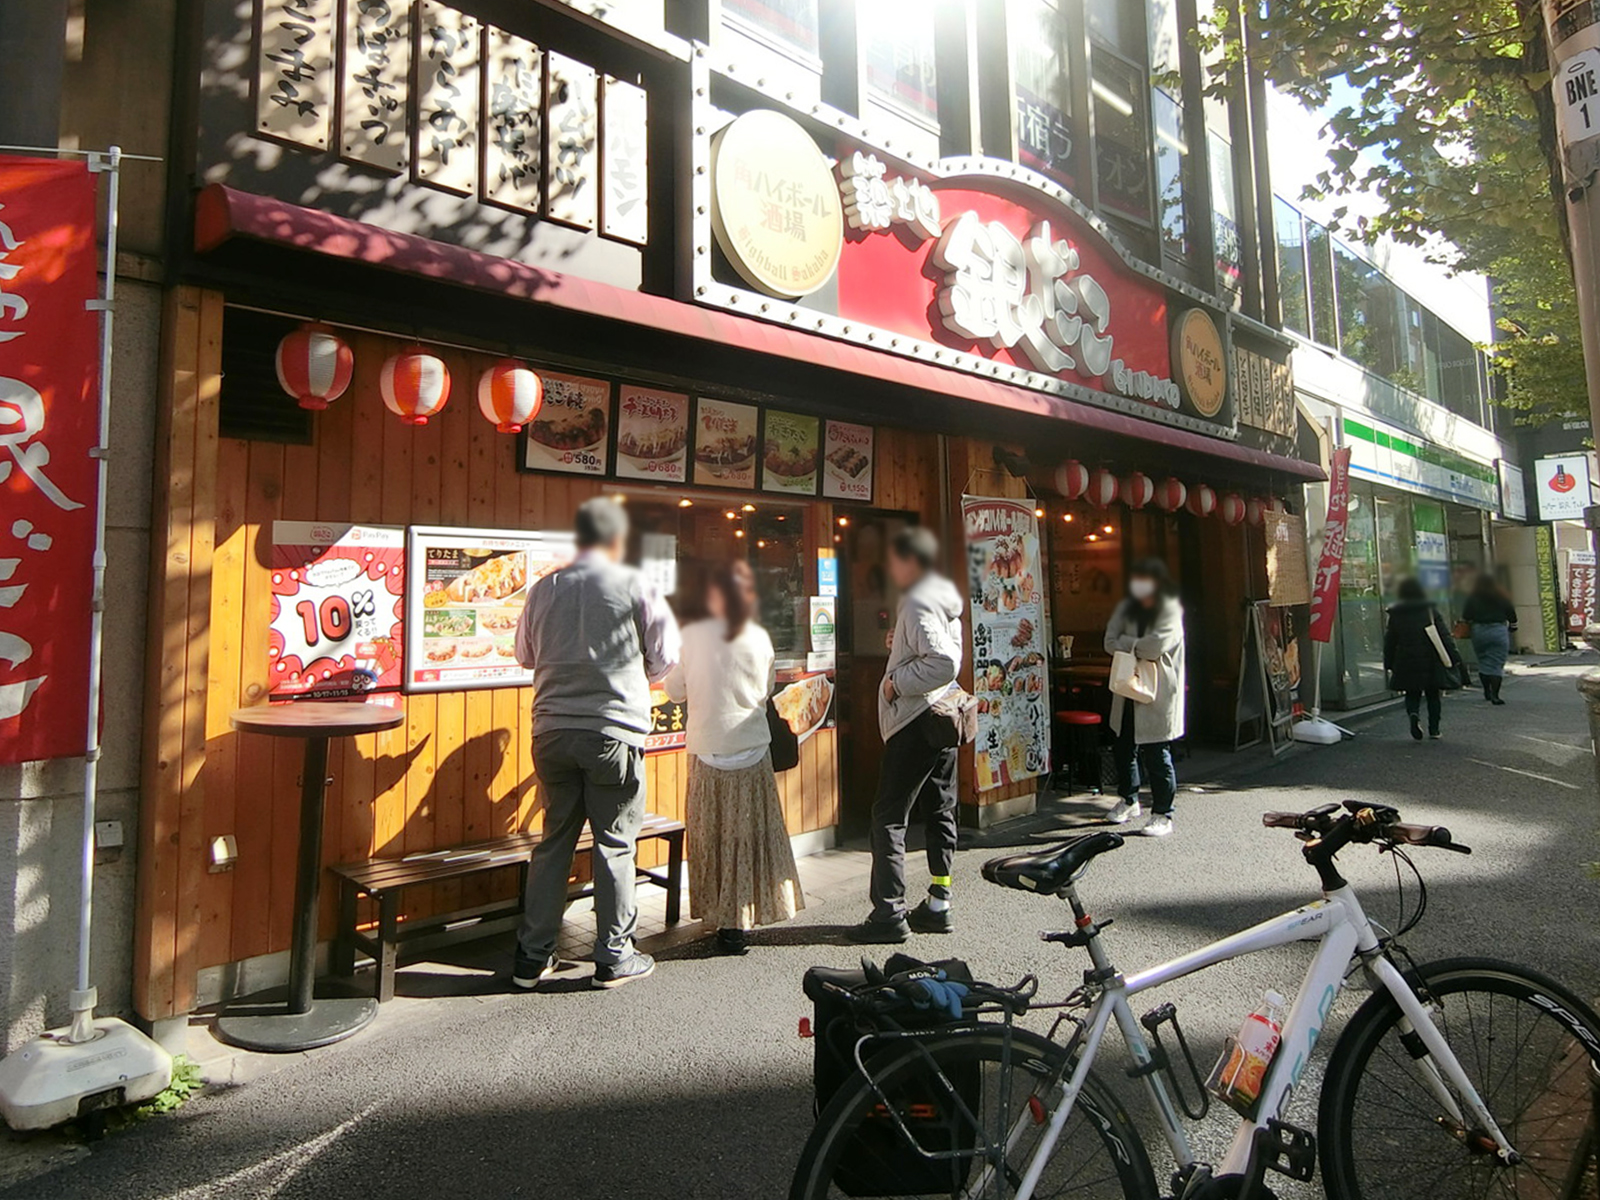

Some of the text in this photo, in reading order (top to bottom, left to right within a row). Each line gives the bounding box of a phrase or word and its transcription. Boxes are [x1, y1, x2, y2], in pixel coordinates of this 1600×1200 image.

[428, 25, 470, 166] からあげ
[1565, 69, 1598, 106] BNE
[1580, 103, 1591, 129] 1
[733, 157, 832, 218] 角ハイボール
[759, 197, 807, 243] 酒場
[940, 209, 1114, 376] 銀だこ
[428, 549, 459, 559] てりたま
[296, 589, 376, 648] 10%
[650, 705, 683, 731] たま
[1287, 912, 1324, 930] SPEAR
